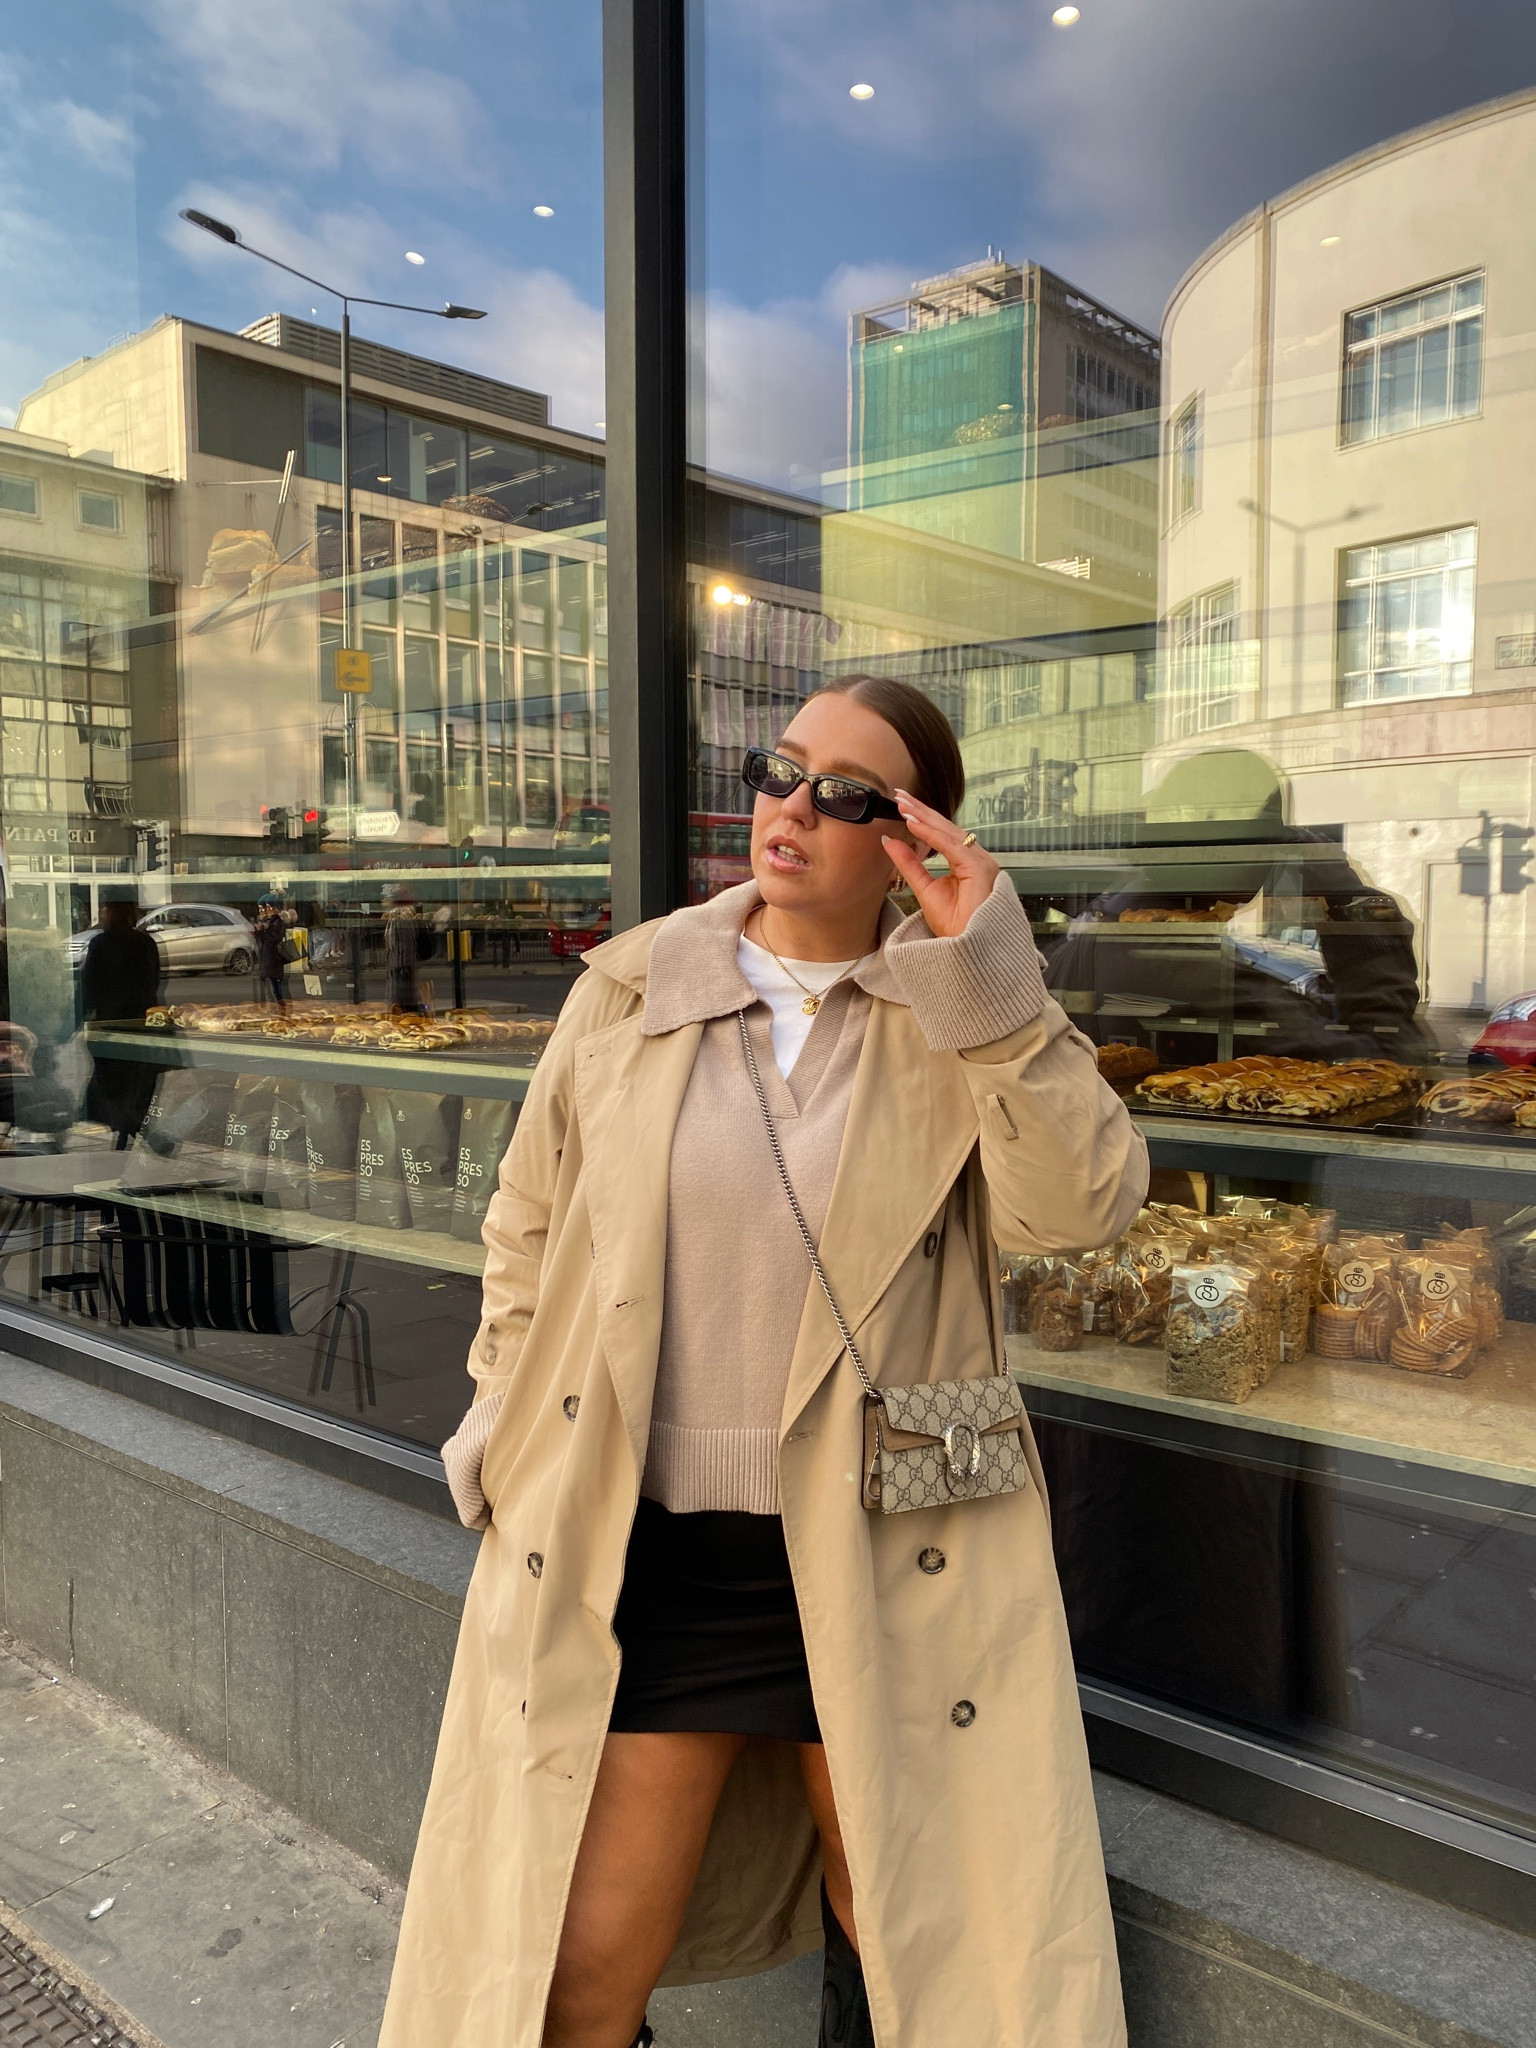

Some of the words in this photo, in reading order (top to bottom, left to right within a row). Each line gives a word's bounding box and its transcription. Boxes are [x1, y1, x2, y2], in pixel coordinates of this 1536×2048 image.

[360, 1139, 372, 1152] ES
[360, 1152, 384, 1167] PRES
[401, 1147, 413, 1161] ES
[459, 1147, 471, 1161] ES
[359, 1165, 373, 1178] SO
[403, 1160, 433, 1174] PRES
[458, 1160, 483, 1177] PRES
[406, 1173, 420, 1186] SO
[456, 1173, 470, 1188] SO
